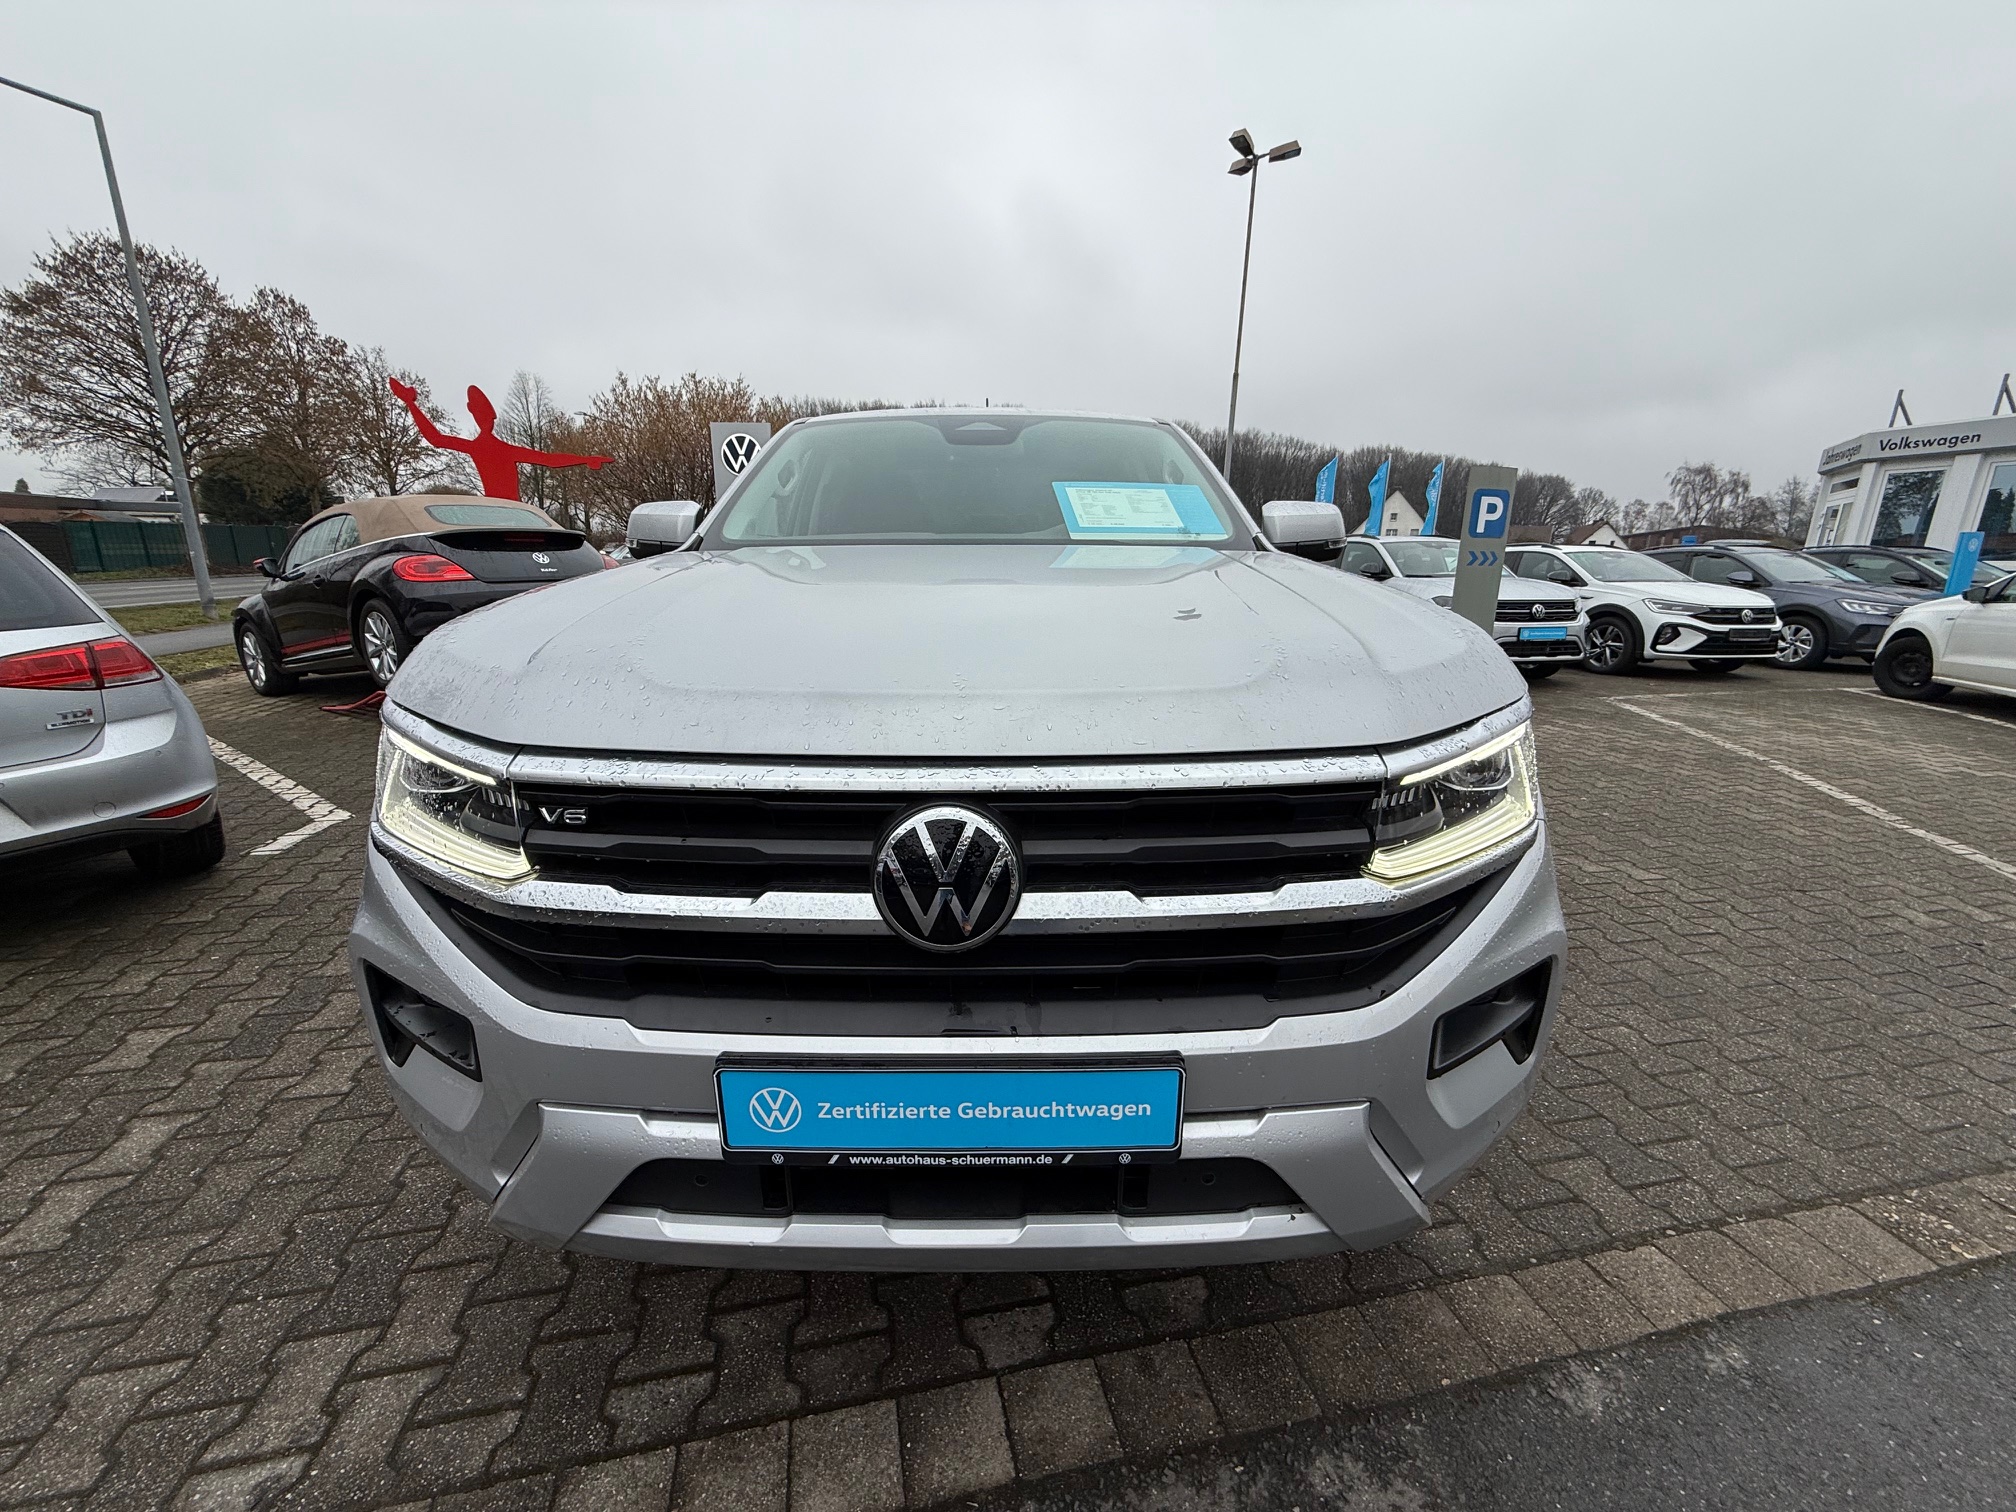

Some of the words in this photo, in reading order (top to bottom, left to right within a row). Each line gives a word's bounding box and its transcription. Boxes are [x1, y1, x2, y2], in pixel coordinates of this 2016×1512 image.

[1879, 433, 1982, 452] Volkswagen
[1822, 443, 1862, 466] Jahreswagen
[1476, 495, 1504, 534] P
[538, 807, 587, 825] V6
[874, 806, 1020, 950] VW
[750, 1087, 801, 1133] VW
[817, 1102, 951, 1119] Zertifizierte
[957, 1101, 1151, 1121] Gebrauchtwagen
[849, 1154, 1053, 1165] www.autohaus-schuermann.de
